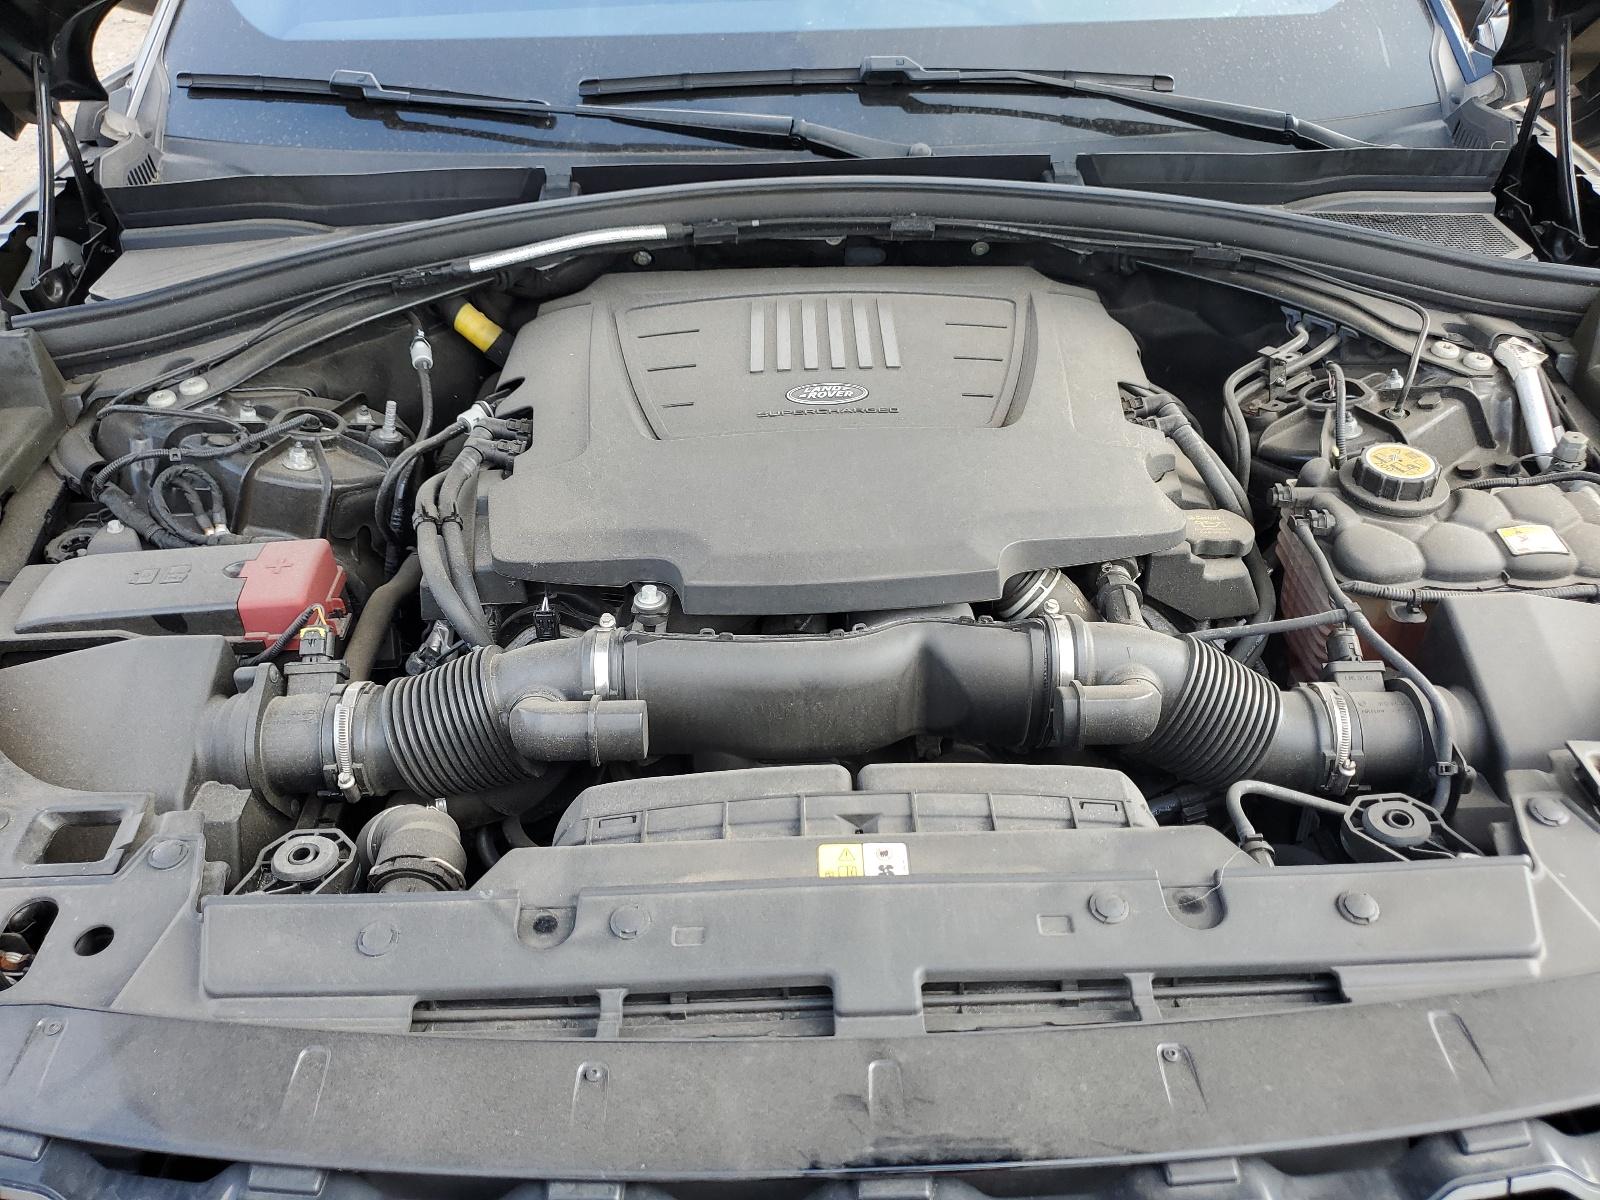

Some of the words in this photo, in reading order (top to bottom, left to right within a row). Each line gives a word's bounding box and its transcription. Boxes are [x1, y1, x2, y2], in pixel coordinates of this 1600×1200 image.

[803, 385, 842, 393] LAND
[807, 390, 855, 399] ROVER
[756, 407, 900, 418] SUPERCHARGED
